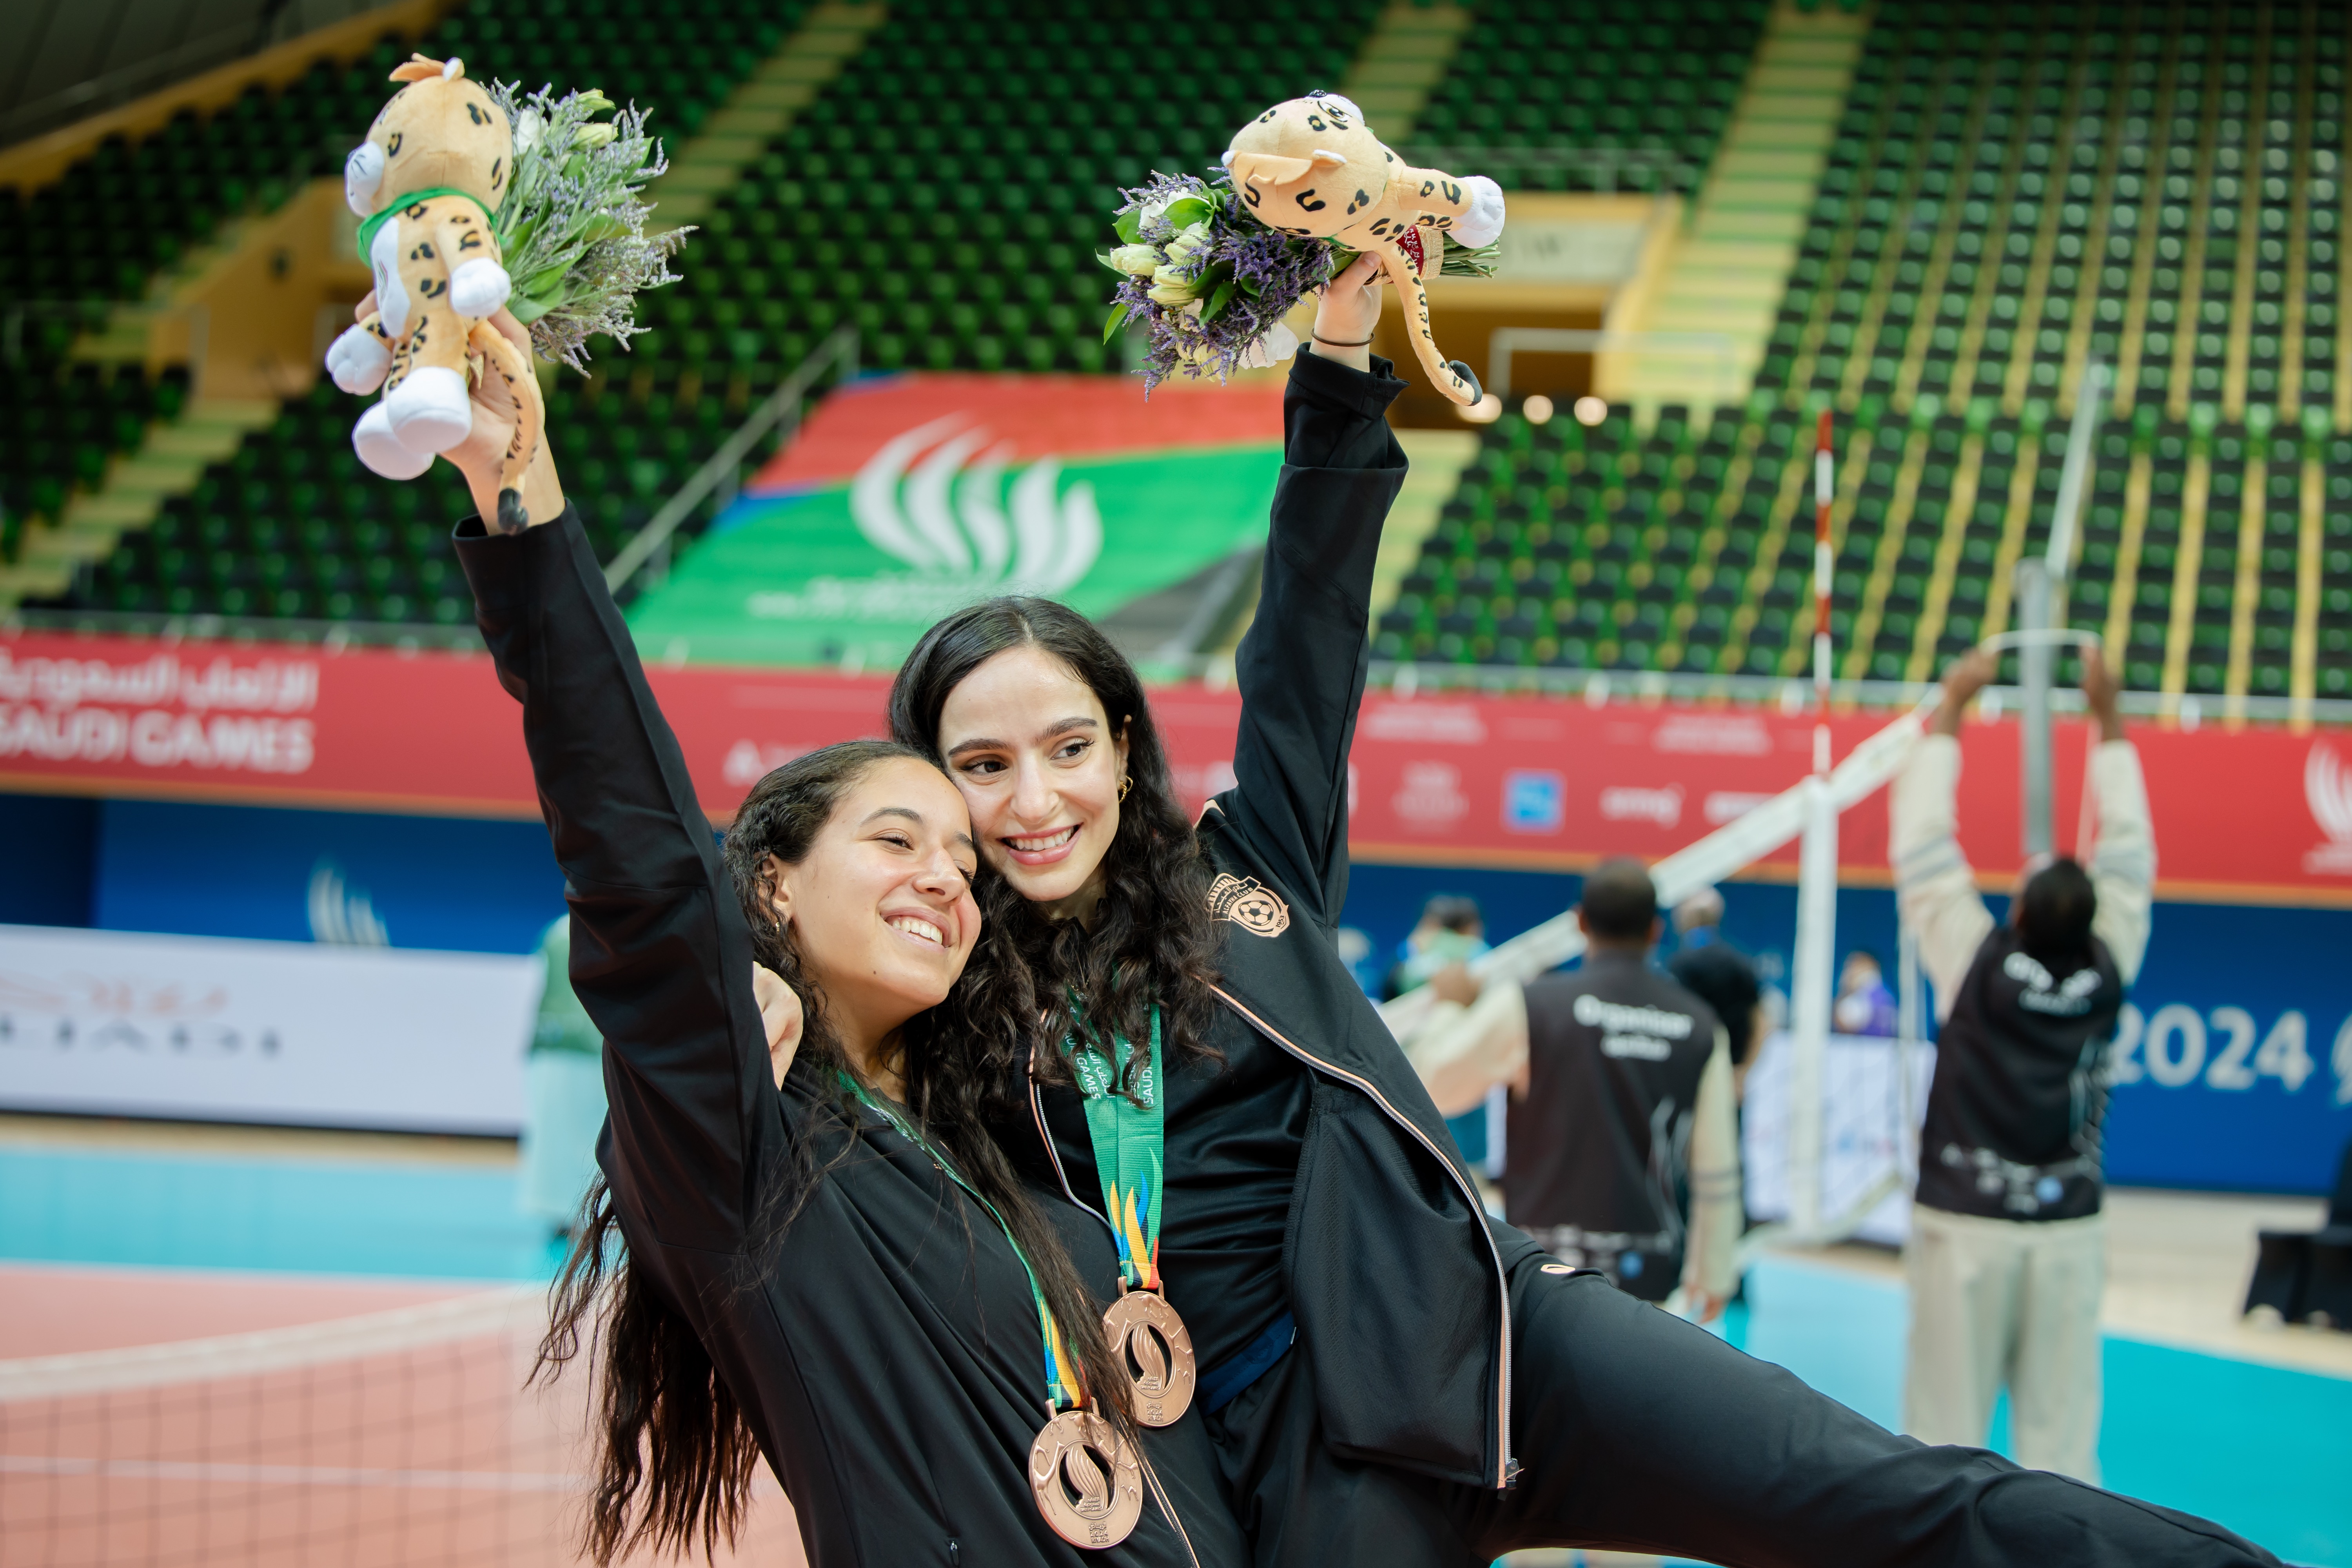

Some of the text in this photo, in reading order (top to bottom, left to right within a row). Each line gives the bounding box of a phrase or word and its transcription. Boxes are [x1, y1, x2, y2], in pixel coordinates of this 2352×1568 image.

[130, 710, 314, 774] GAMES
[1223, 887, 1254, 914] ALFAYHA CLUB
[1276, 915, 1285, 927] 1953
[2106, 1001, 2315, 1094] 2024
[1076, 1057, 1102, 1100] GAMES
[1142, 1066, 1154, 1105] SAUDI
